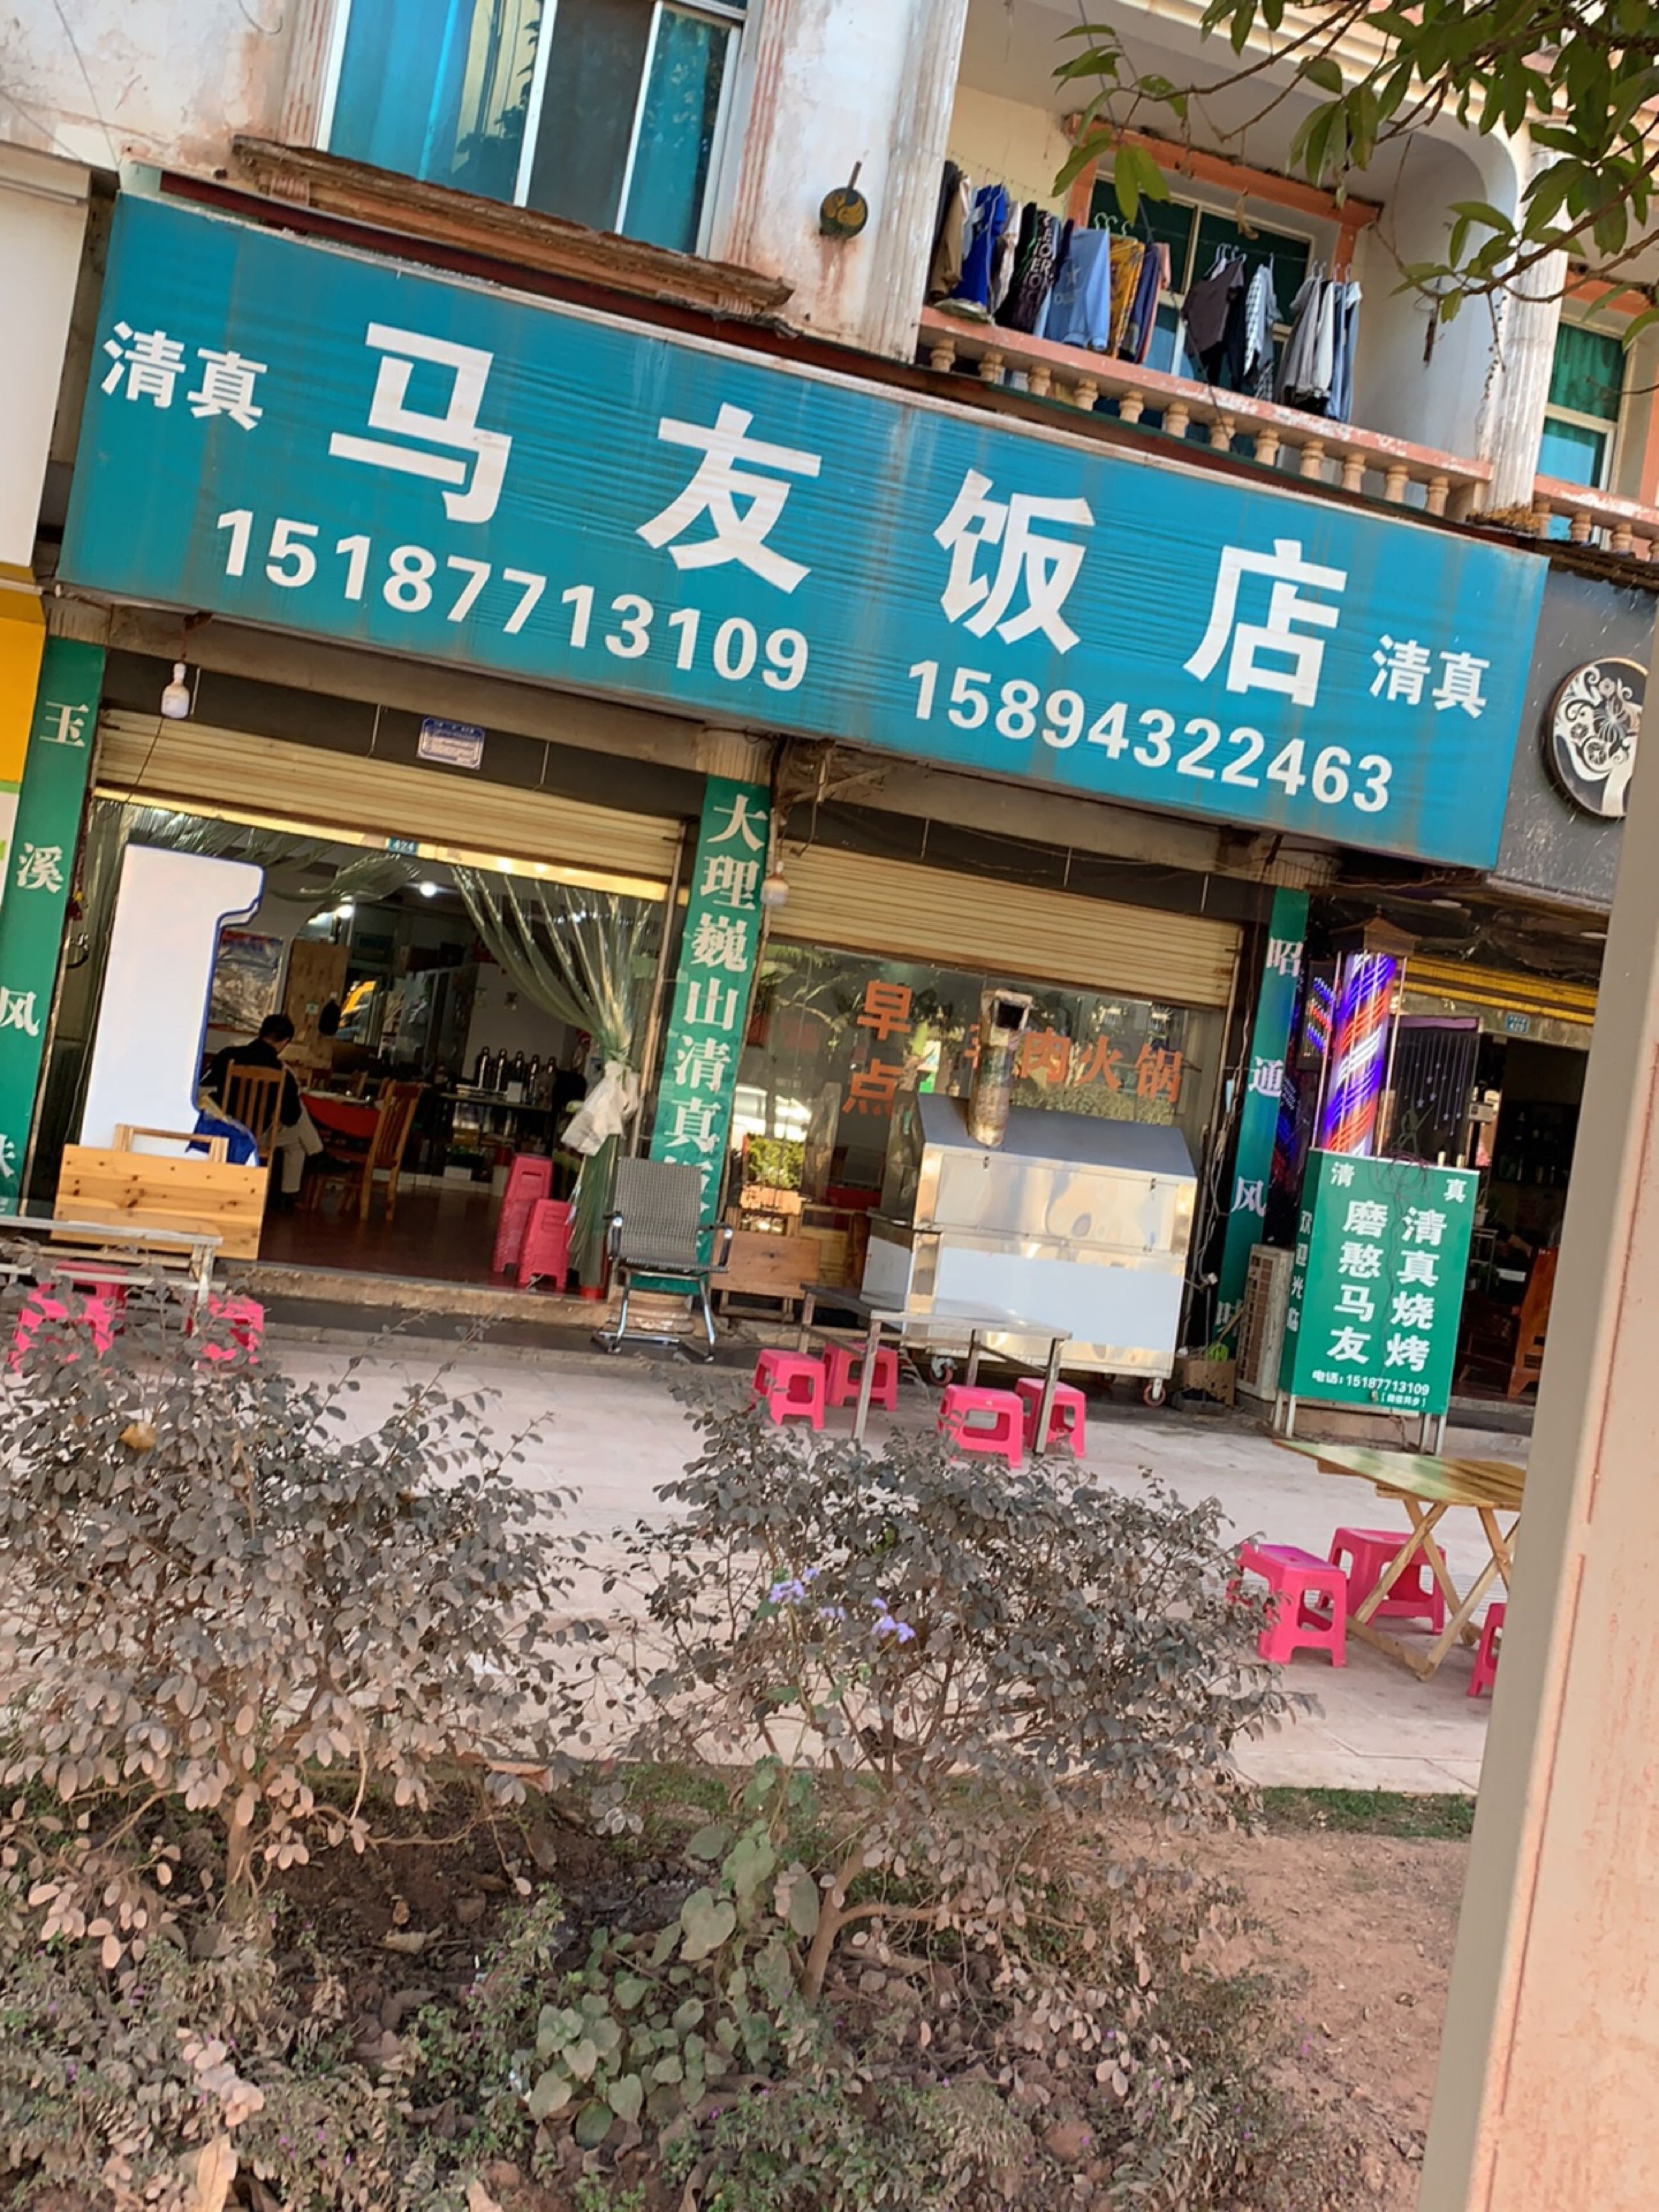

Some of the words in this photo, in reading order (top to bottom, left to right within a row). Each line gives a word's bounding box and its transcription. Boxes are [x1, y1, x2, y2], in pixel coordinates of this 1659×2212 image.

[101, 321, 268, 431] 清真
[329, 323, 1349, 710] 马友饭店
[217, 509, 808, 691] 15187713109
[1370, 634, 1490, 719] 清真
[909, 660, 1393, 813] 15894322463
[0, 700, 90, 1179] 玉溪风
[662, 794, 768, 1247] 大理巍山清真
[842, 980, 911, 1115] 早点
[964, 1024, 1183, 1102] 肉火锅
[1330, 1161, 1356, 1187] 清
[1443, 1179, 1467, 1203] 真
[1326, 1199, 1389, 1365] 磨憨马友
[1384, 1206, 1448, 1373] 清真烧烤
